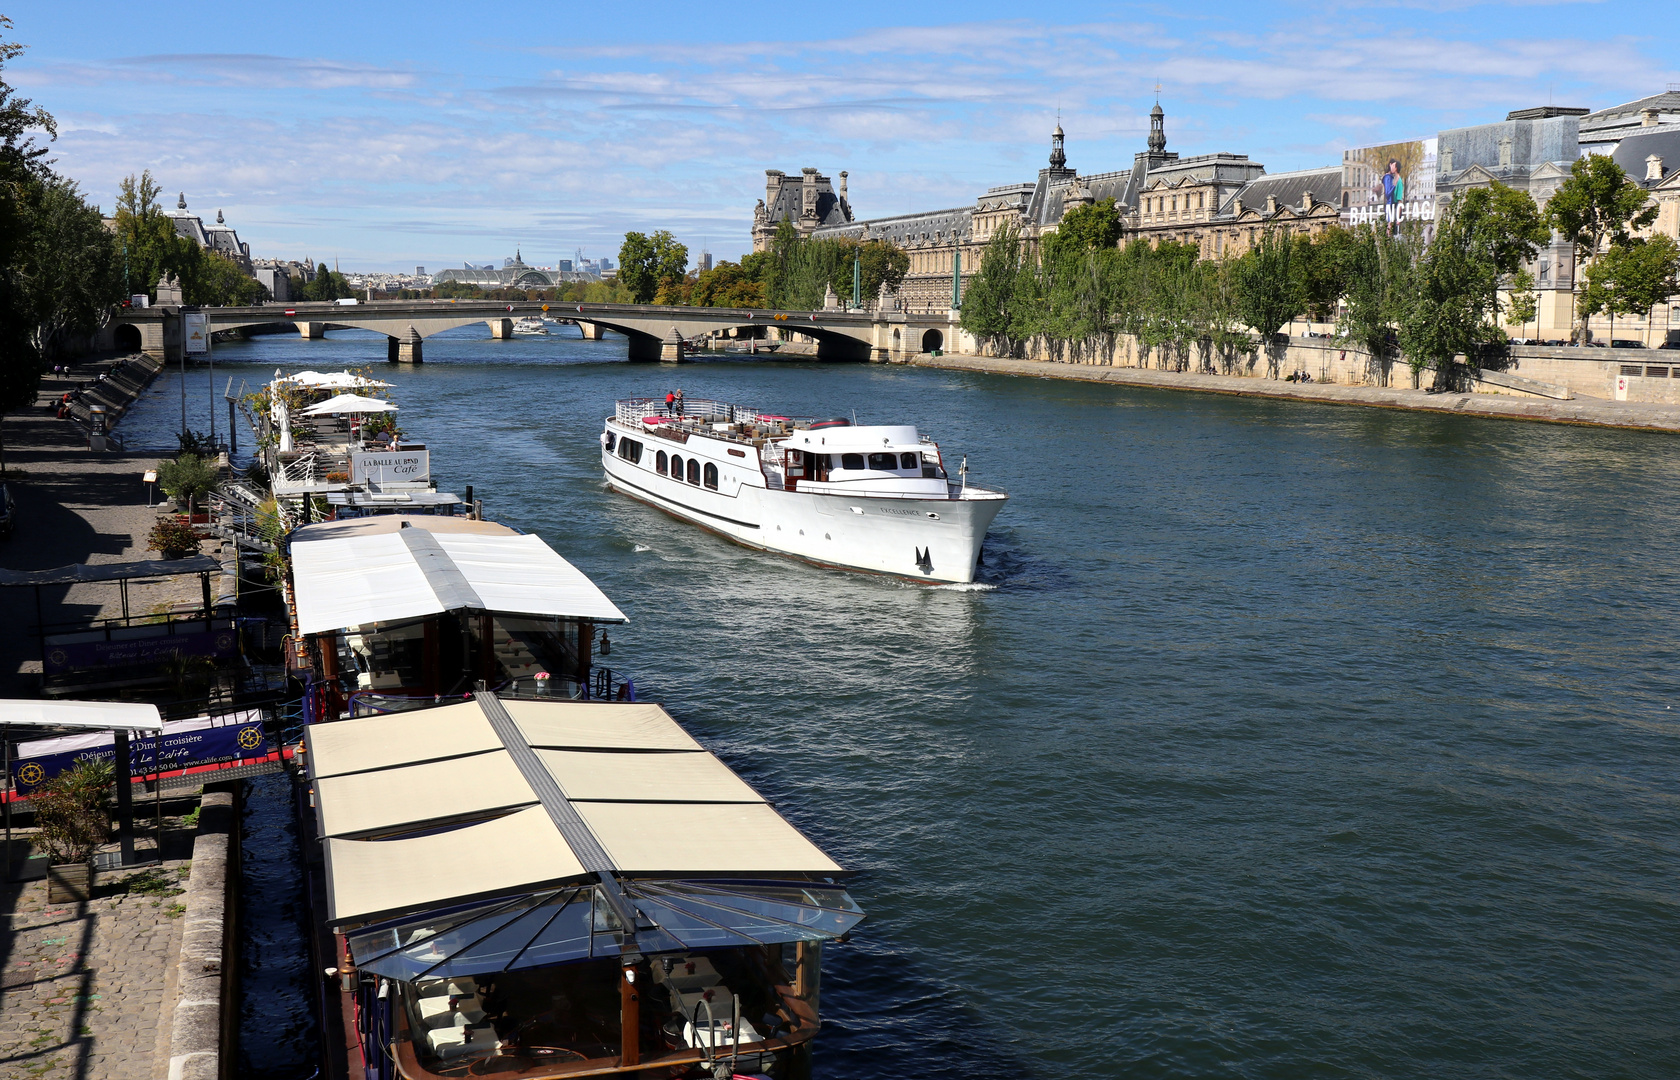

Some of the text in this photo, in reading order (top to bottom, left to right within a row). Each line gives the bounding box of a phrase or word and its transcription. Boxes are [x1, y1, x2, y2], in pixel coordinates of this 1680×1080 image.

[393, 464, 418, 475] Café
[880, 507, 921, 517] EXCELLENCE
[164, 735, 202, 747] croisière
[140, 753, 153, 763] Le
[158, 747, 190, 760] Calife
[158, 763, 168, 771] 50
[182, 755, 233, 767] www.calife.com
